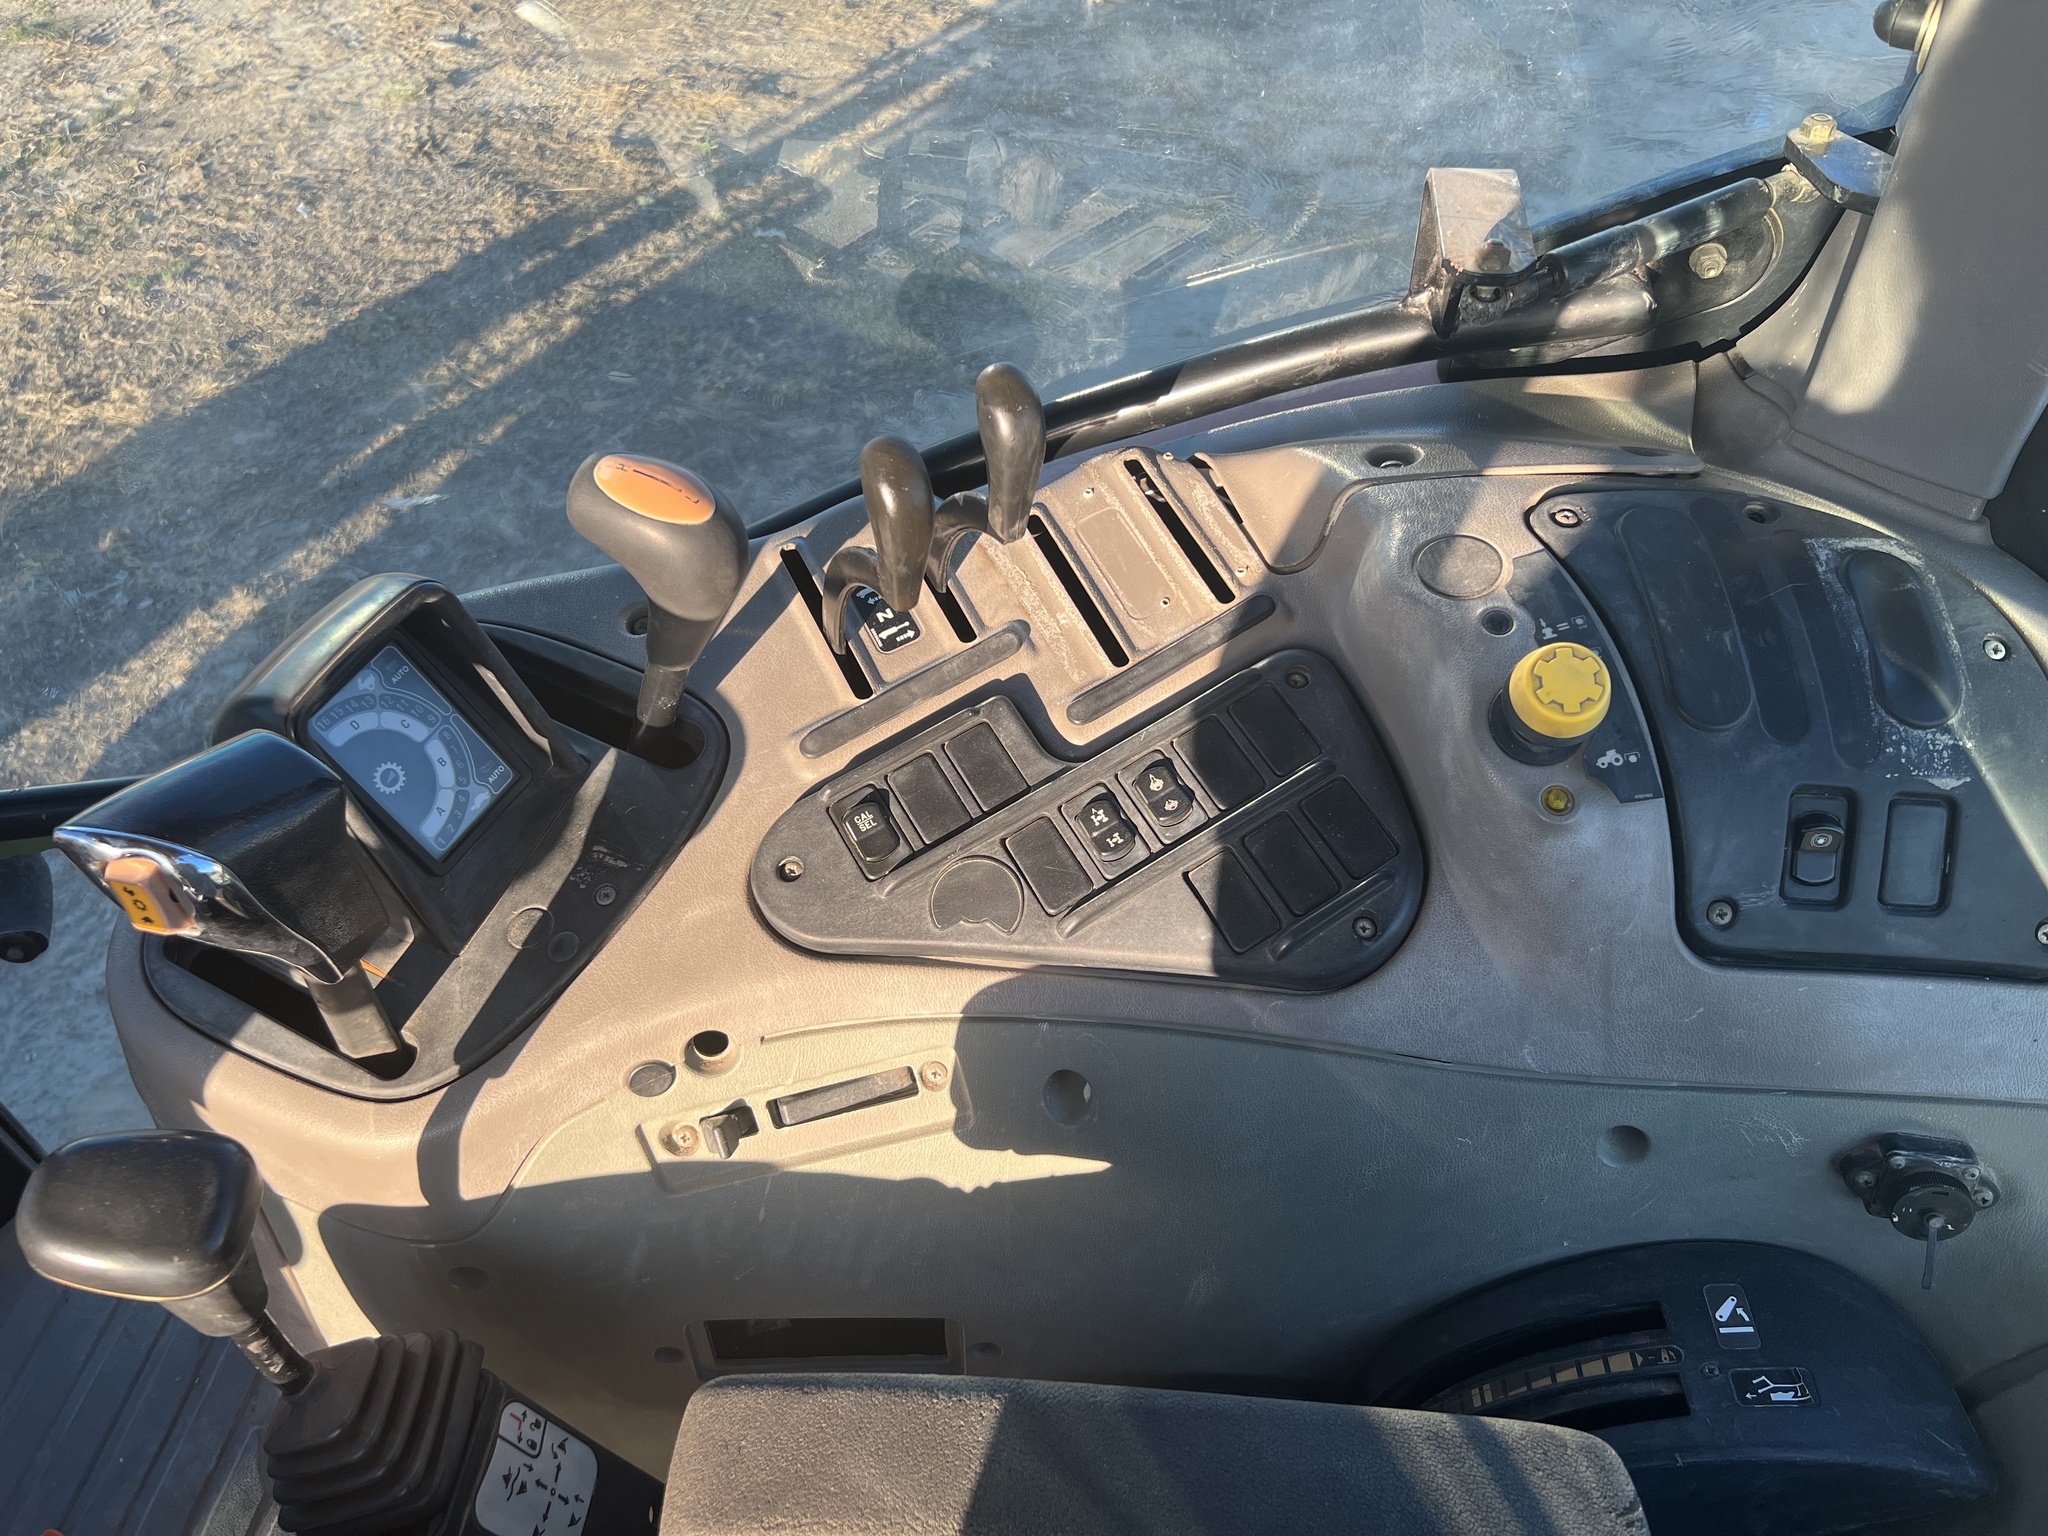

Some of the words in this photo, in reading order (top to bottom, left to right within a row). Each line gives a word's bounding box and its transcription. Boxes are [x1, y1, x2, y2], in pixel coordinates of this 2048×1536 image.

[876, 607, 894, 623] N
[391, 665, 409, 684] AUTO
[317, 716, 331, 729] 16
[330, 707, 344, 720] 15
[345, 700, 359, 713] 14
[361, 695, 375, 708] 13
[381, 695, 394, 708] 12
[396, 699, 409, 712] 11
[411, 704, 424, 717] 10
[427, 714, 436, 723] 9
[349, 720, 360, 730] D
[400, 719, 410, 729] C
[442, 731, 451, 739] 8
[437, 757, 447, 767] B
[456, 760, 464, 768] 6
[458, 775, 467, 784] 5
[488, 765, 505, 784] AUTO
[458, 794, 467, 803] 4
[436, 806, 446, 816] A
[453, 809, 463, 819] 3
[853, 810, 874, 824] CAL
[446, 823, 456, 833] 2
[858, 819, 878, 832] SEL
[438, 837, 446, 845] 1
